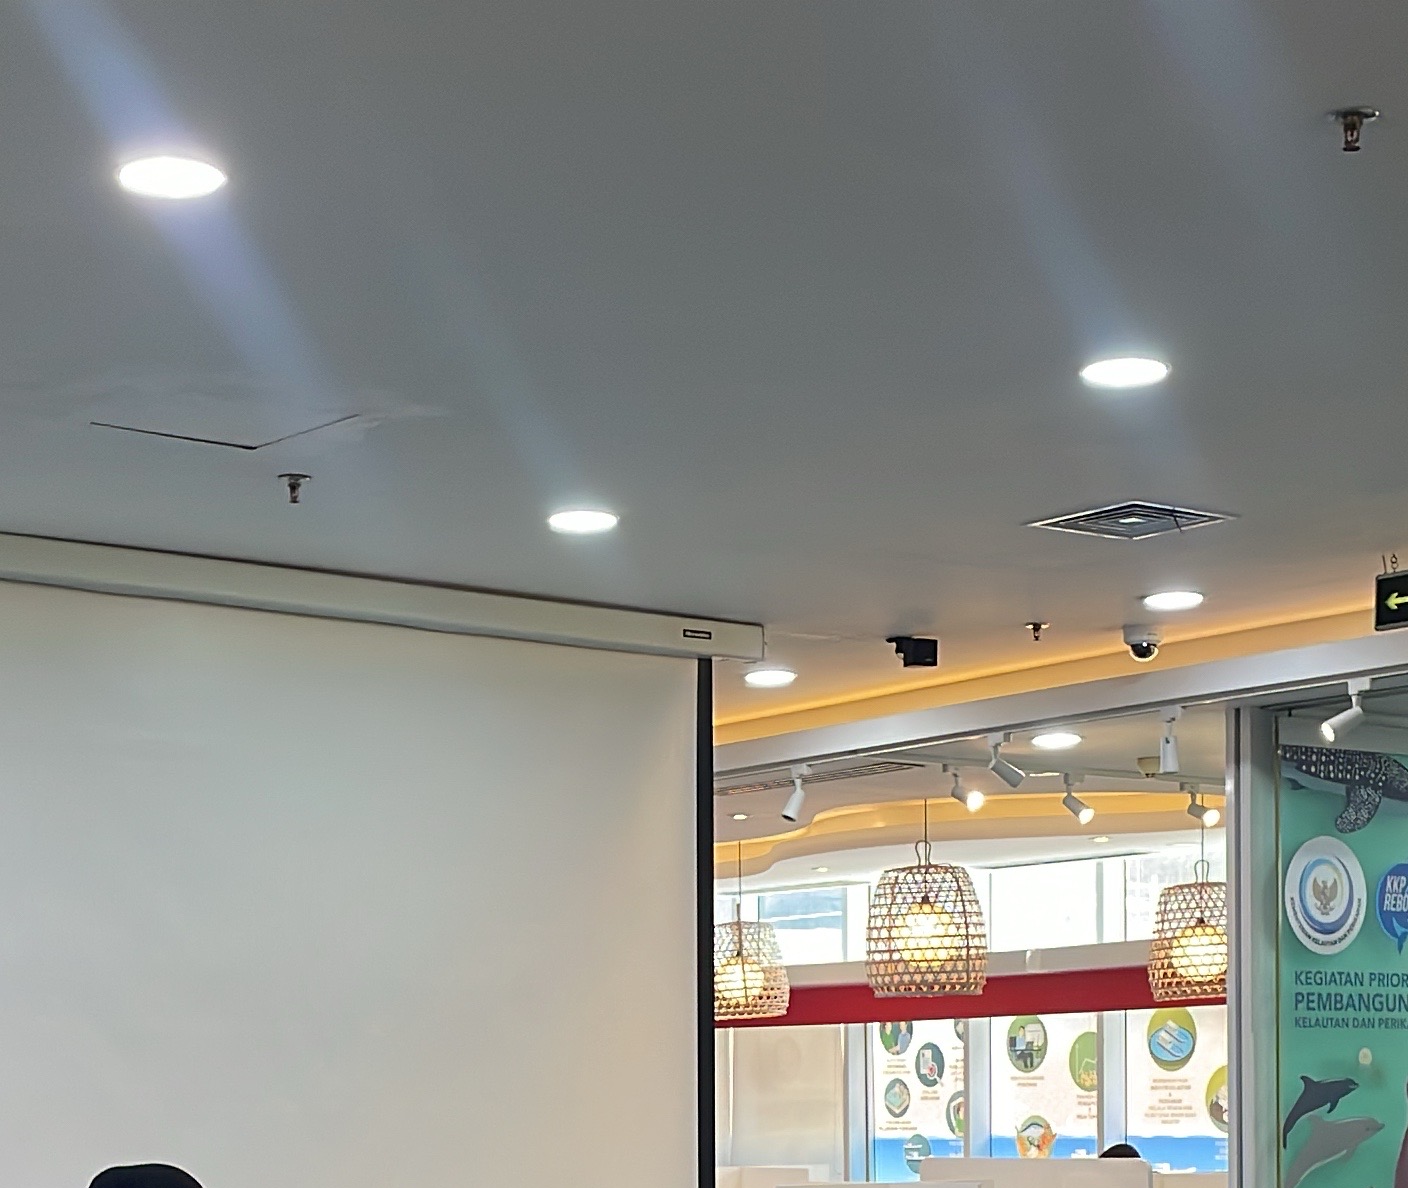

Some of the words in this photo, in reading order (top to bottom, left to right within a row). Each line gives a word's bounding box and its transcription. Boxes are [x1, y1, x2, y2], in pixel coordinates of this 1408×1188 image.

[1386, 875, 1407, 894] KKP
[1294, 970, 1365, 987] KEGIATAN
[1294, 1017, 1349, 1029] KELAUTAN
[1352, 1017, 1375, 1029] DAN
